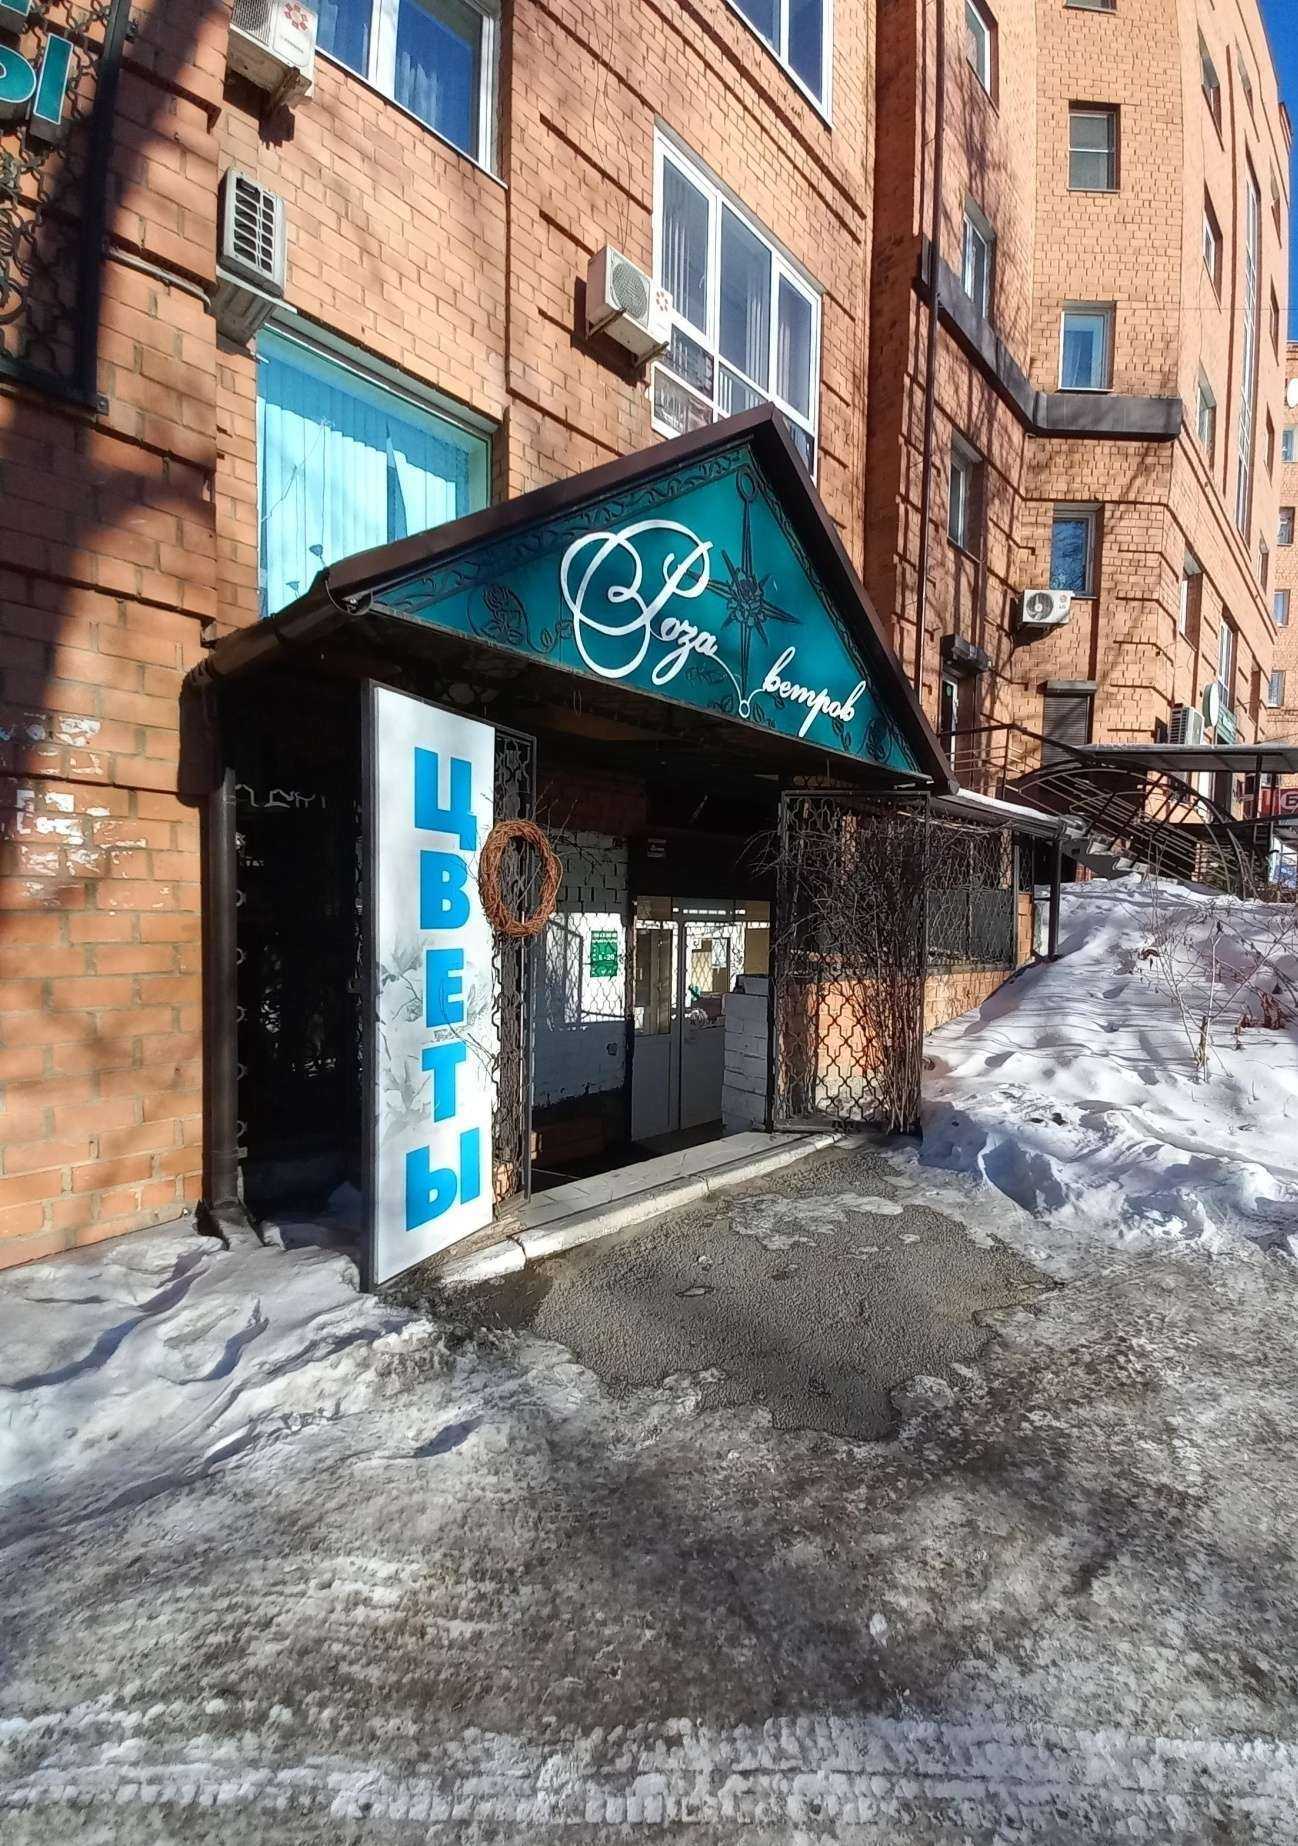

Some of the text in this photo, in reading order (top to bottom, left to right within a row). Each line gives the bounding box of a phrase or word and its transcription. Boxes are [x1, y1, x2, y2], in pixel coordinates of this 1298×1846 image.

[560, 519, 867, 738] Роза ветров
[406, 746, 480, 1232] ЦВЕТЫ
